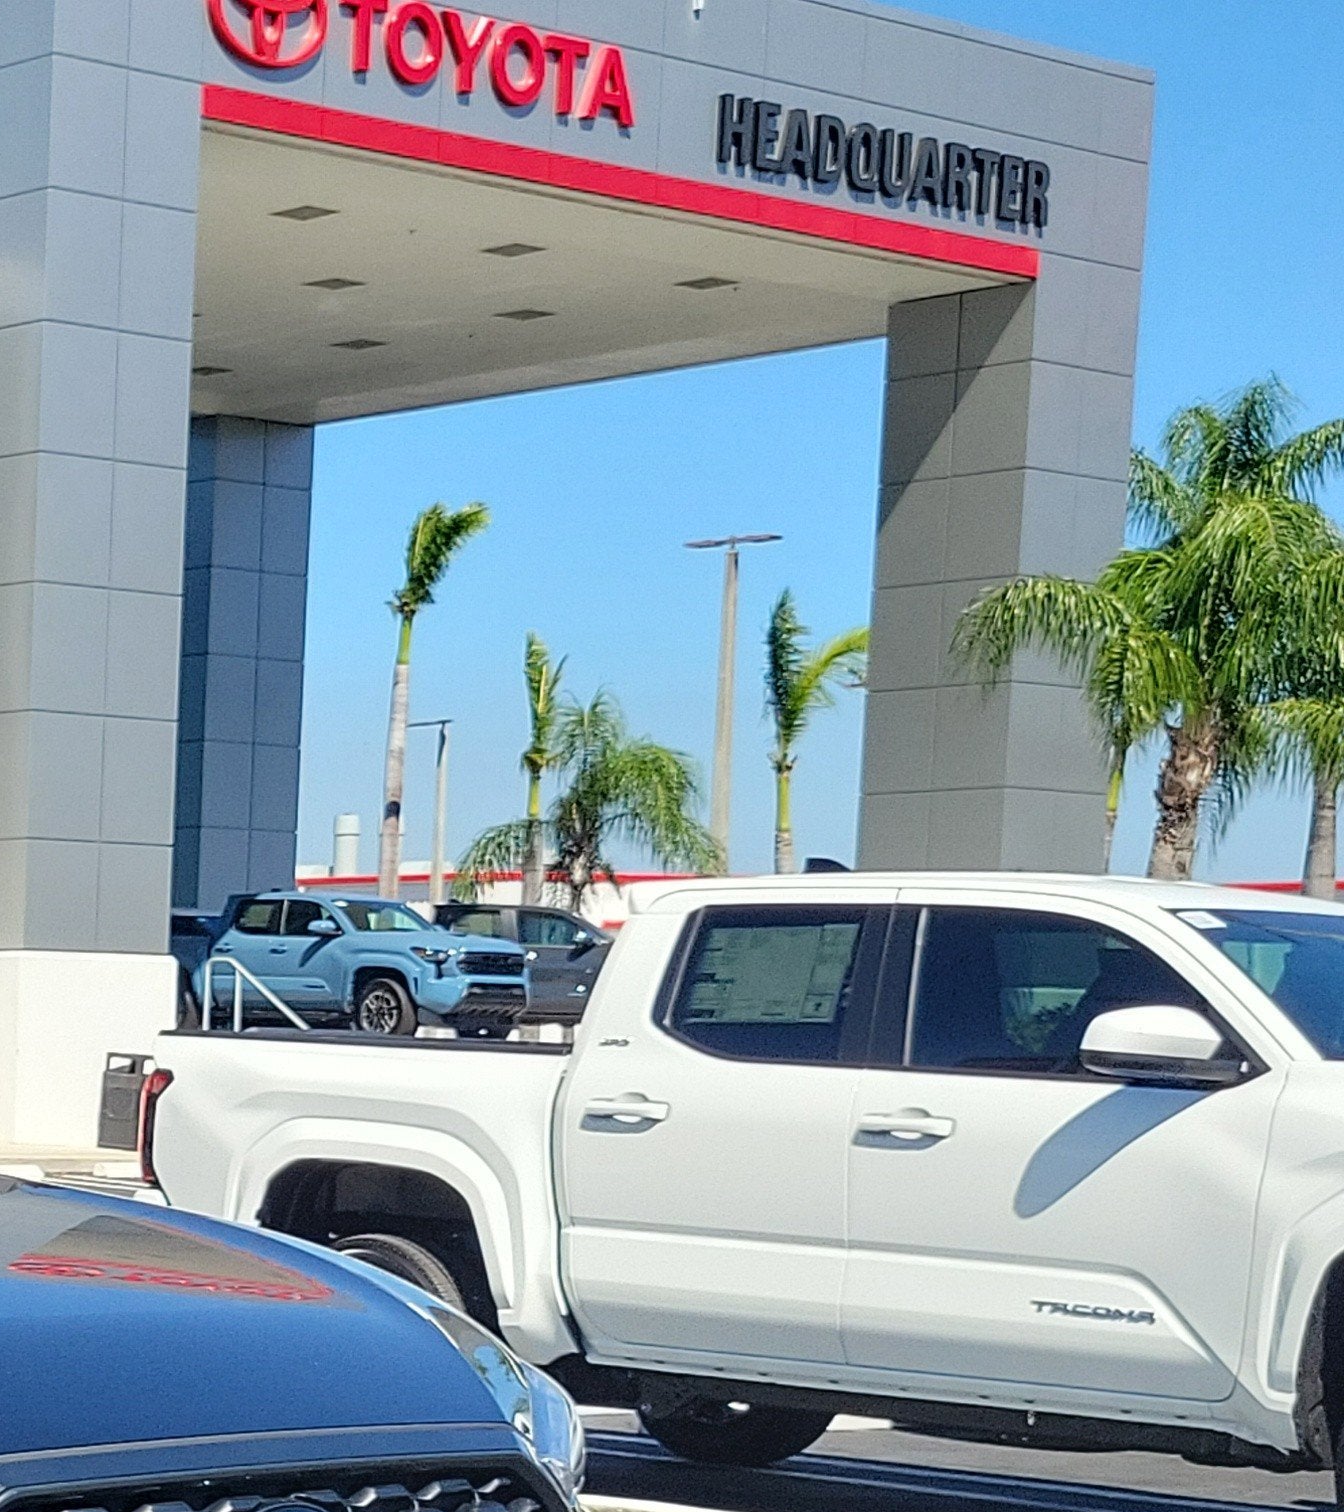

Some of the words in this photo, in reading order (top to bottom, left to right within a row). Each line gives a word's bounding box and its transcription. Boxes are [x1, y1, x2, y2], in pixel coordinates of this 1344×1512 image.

[339, 0, 633, 127] TOYOTA
[716, 94, 1050, 229] HEADQUARTER
[1030, 1300, 1155, 1325] TACOMA
